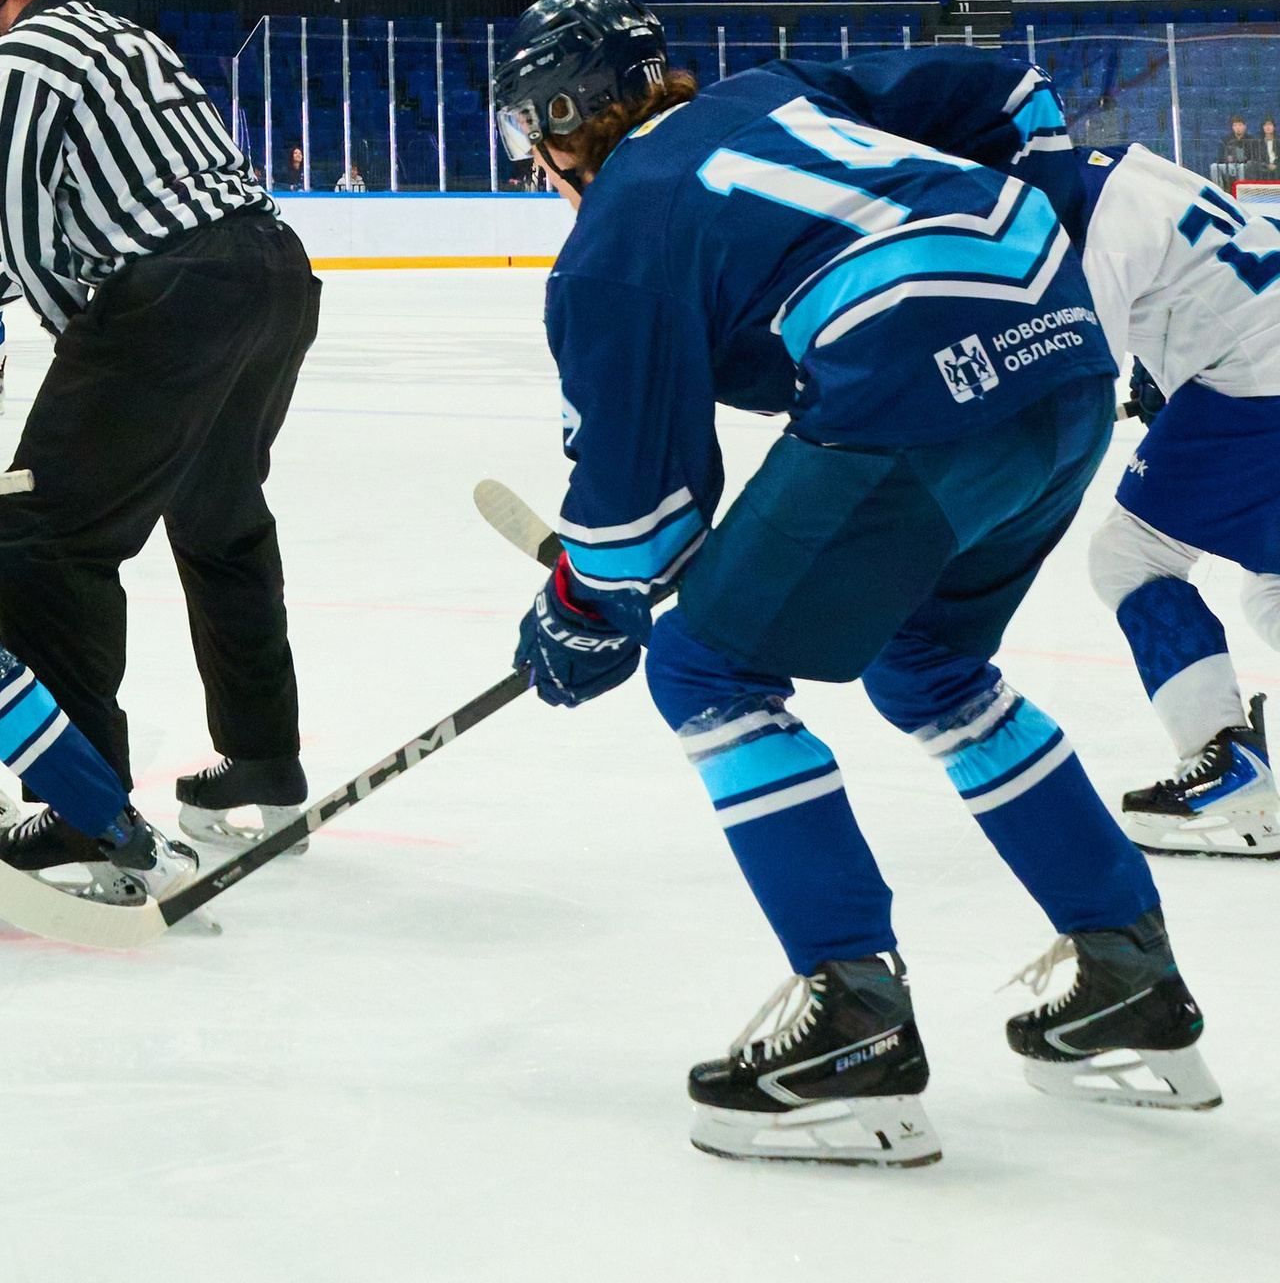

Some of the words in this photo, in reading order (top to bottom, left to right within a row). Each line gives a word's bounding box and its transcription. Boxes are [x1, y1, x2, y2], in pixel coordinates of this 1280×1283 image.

[958, 2, 970, 13] 11
[696, 95, 984, 236] 14
[1004, 331, 1084, 372] ОБЛАСТЬ
[306, 714, 458, 832] CCM
[835, 1034, 900, 1073] BAUER
